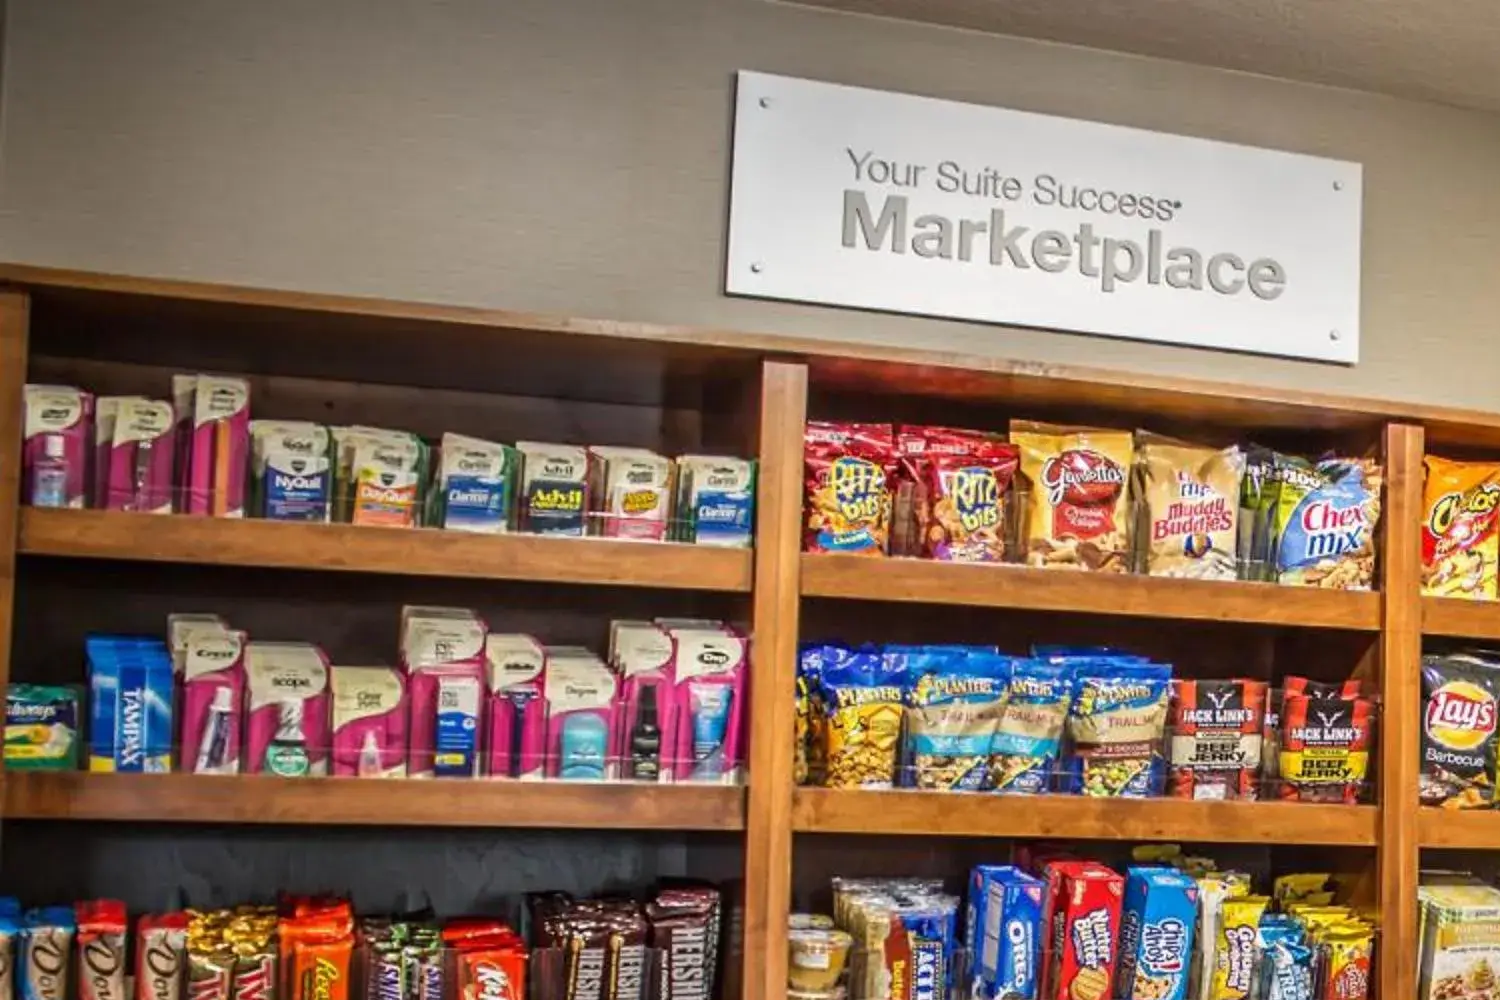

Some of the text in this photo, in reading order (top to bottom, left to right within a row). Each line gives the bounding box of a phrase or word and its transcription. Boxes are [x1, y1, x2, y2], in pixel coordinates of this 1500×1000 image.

[846, 147, 925, 189] Your
[936, 159, 1023, 201] Suite
[841, 189, 1287, 300] Marketplace
[275, 475, 322, 490] NyQuil
[543, 464, 575, 476] Advil
[953, 468, 997, 504] RITZ
[531, 488, 582, 511] Advil
[1168, 497, 1226, 520] Muddy
[962, 506, 998, 531] bits
[1153, 510, 1234, 541] Buddies
[1303, 500, 1366, 531] Chex
[1011, 679, 1054, 695] ANTERS
[1183, 706, 1254, 723] JACK LINK'S
[1430, 692, 1495, 728] Lay's
[121, 686, 146, 767] TAMPAX
[1291, 726, 1362, 742] JACK LINK'S
[1188, 750, 1246, 764] JERKY
[1196, 741, 1240, 753] BEEF
[1425, 748, 1485, 768] Barbecue
[1295, 767, 1354, 780] JERKY
[1301, 759, 1346, 770] BEEF
[1074, 919, 1098, 969] Butter
[1089, 909, 1112, 962] Nutter
[1162, 920, 1184, 964] Chips
[1008, 920, 1025, 988] OREO
[1236, 926, 1255, 992] Golden
